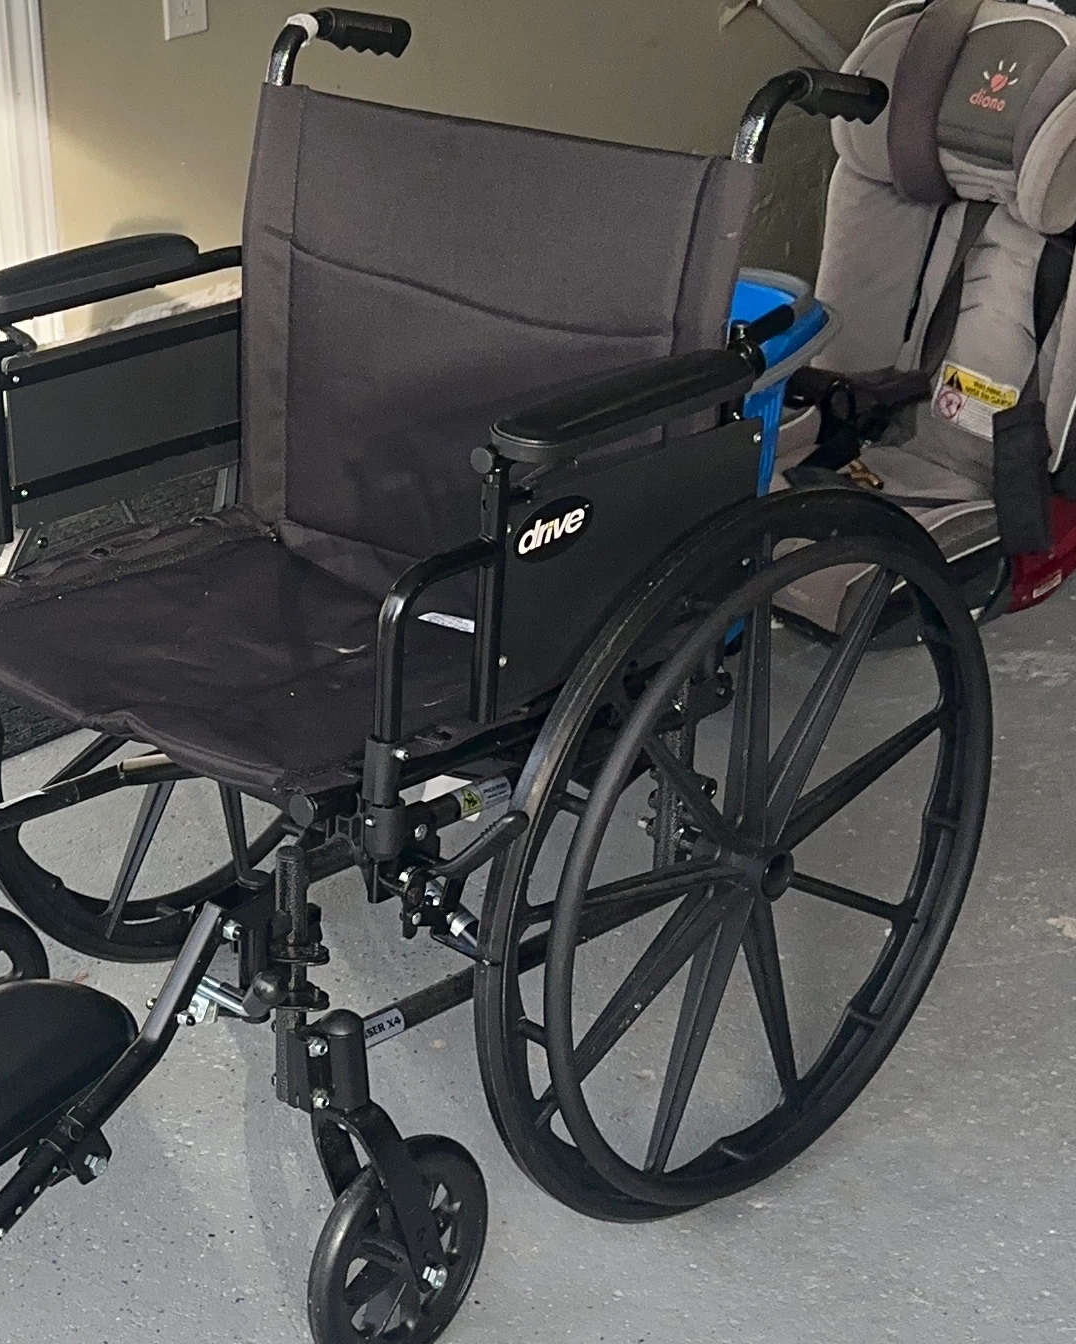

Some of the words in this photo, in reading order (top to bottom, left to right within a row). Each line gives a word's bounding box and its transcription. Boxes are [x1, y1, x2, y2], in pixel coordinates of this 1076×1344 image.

[969, 88, 1005, 111] diono
[518, 508, 585, 554] drive
[365, 1023, 385, 1038] SER
[386, 1016, 401, 1030] X4
